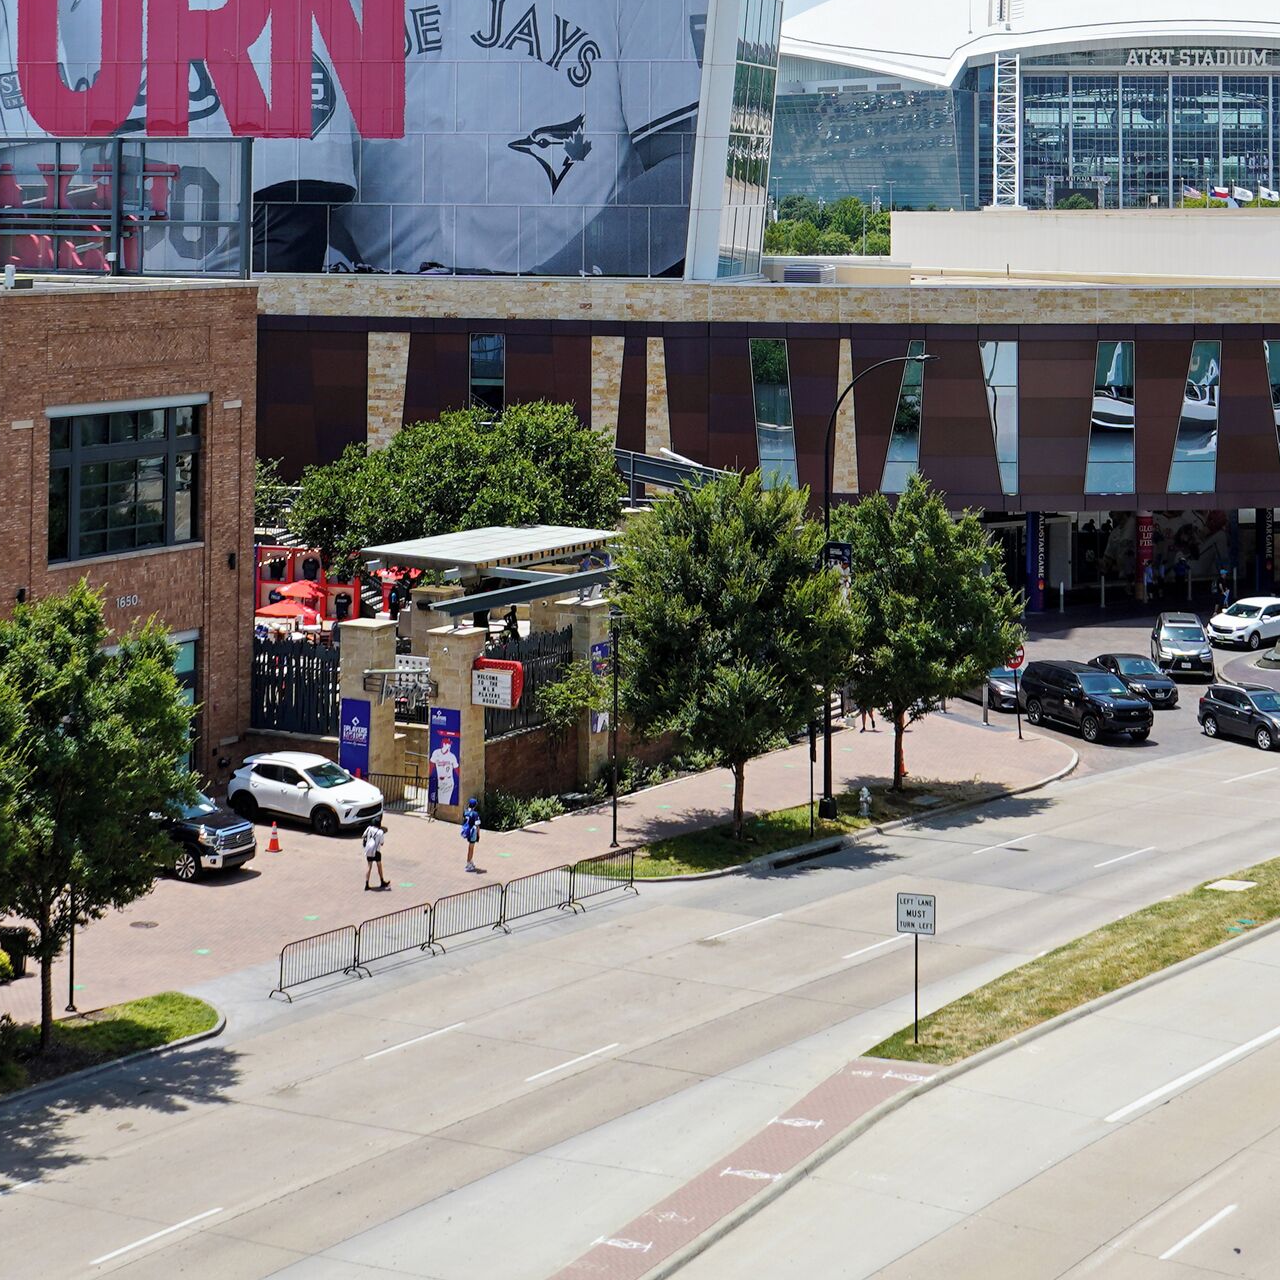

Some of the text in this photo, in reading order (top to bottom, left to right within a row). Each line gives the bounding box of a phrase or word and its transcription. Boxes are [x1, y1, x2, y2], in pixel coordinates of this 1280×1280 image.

[471, 0, 601, 87] JAYS
[1125, 49, 1272, 66] AT&T STADIUM
[116, 594, 138, 608] 1650
[899, 897, 933, 907] LEFT LANE
[906, 909, 926, 918] MUST
[918, 922, 933, 930] LEFT
